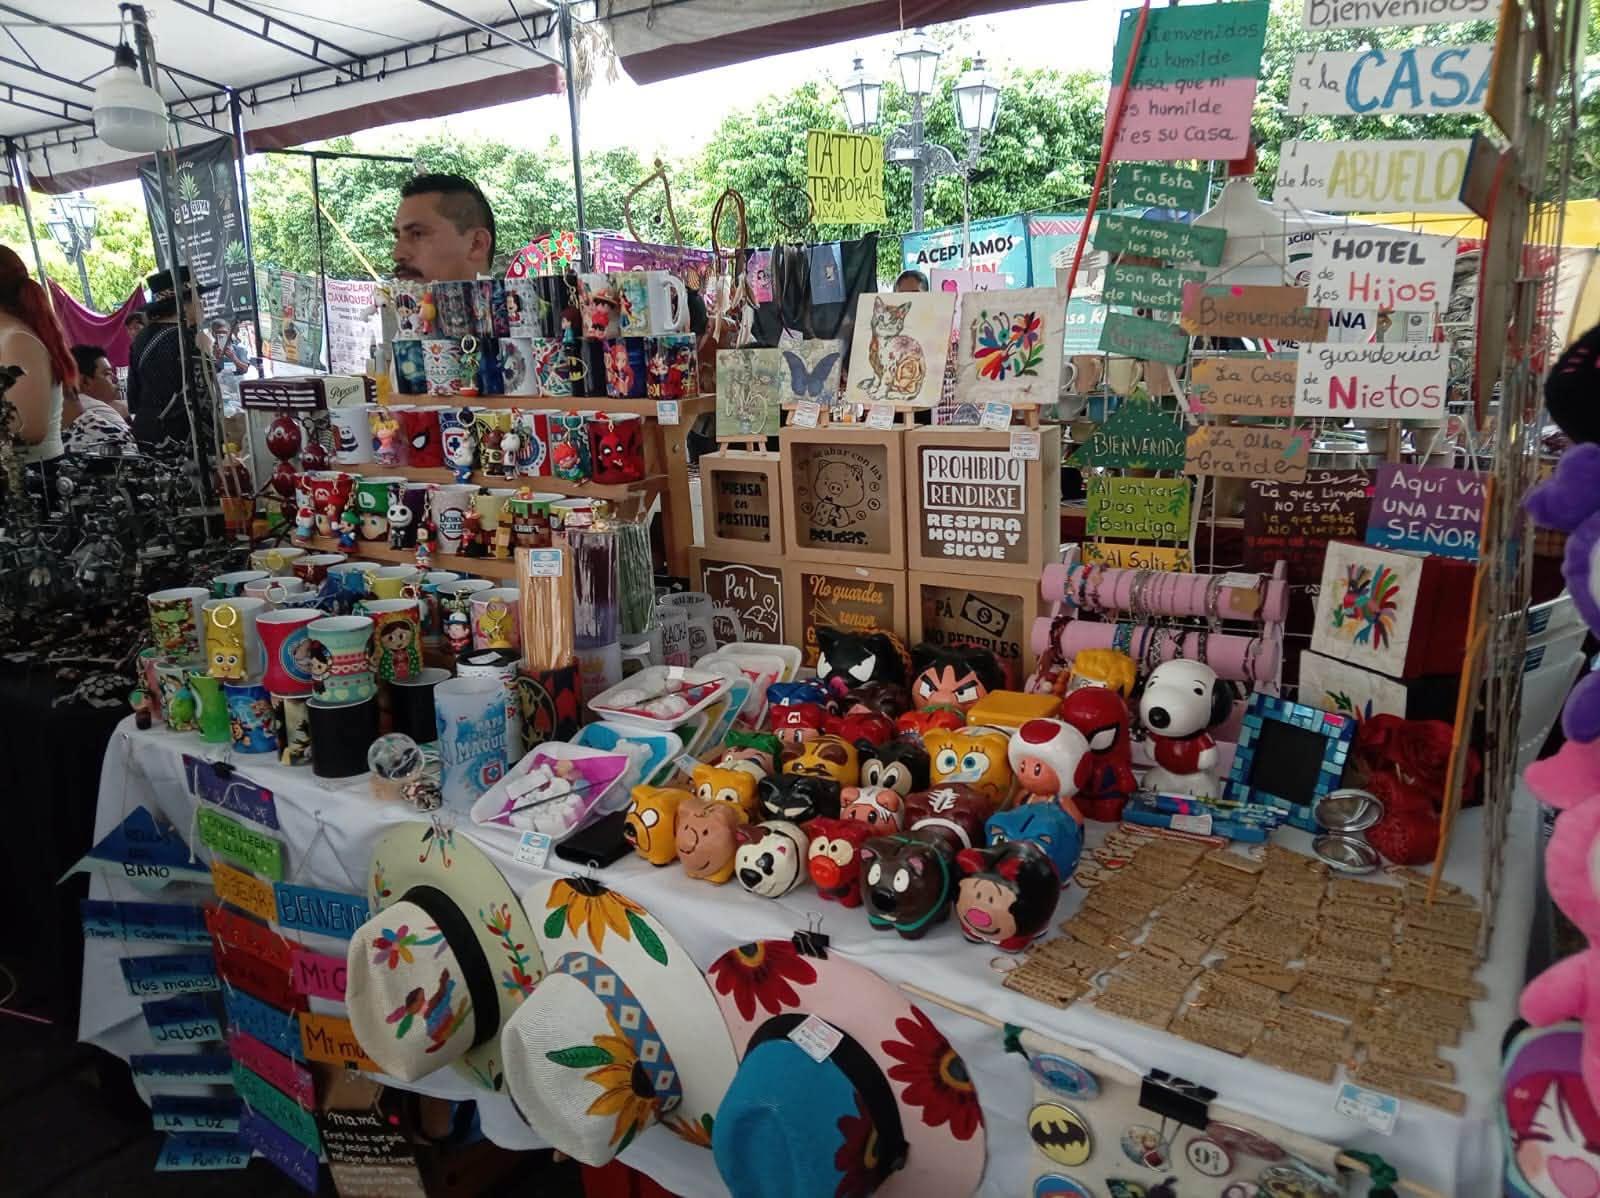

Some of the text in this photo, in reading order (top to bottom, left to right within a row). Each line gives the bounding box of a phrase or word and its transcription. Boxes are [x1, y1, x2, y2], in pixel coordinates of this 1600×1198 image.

[1163, 48, 1233, 68] humilde
[1131, 79, 1169, 92] asa,
[1175, 78, 1204, 95] que
[1299, 76, 1312, 90] a
[1318, 62, 1341, 93] la
[1149, 98, 1222, 116] humilde
[1130, 130, 1152, 145] es
[1158, 128, 1178, 142] su
[809, 131, 873, 177] TATTO
[1133, 169, 1195, 190] En Esta
[1277, 170, 1296, 188] de
[1300, 164, 1325, 188] los
[1133, 187, 1178, 208] Casa
[916, 235, 1013, 264] ACEPTAMOS
[1127, 241, 1195, 260] los gatos
[1331, 238, 1426, 266] HOTEL
[1115, 270, 1145, 284] Son
[1318, 267, 1336, 281] de
[1105, 285, 1185, 306] de Nuestr
[1348, 271, 1438, 313] Hijos
[1216, 366, 1295, 384] La Casa
[1304, 372, 1320, 385] de
[1199, 390, 1218, 405] ES
[1328, 374, 1442, 411] Nietos
[928, 454, 1021, 481] PROHIBIDO
[1199, 450, 1291, 475] Grande
[1259, 486, 1281, 499] La
[1290, 488, 1315, 502] que
[1390, 470, 1448, 499] Aquí
[930, 484, 1018, 509] RENDIRSE
[1100, 498, 1136, 515] Dios
[1274, 501, 1295, 513] NO
[1382, 497, 1428, 521] UNA
[718, 511, 770, 529] POSITIVO
[927, 513, 1022, 532] RESPIRA
[1100, 516, 1178, 538] Bendiga
[928, 528, 1020, 546] HONDO Y
[1387, 518, 1482, 550] SEÑOR
[943, 544, 1006, 559] SIGUE
[1106, 552, 1123, 568] Al
[810, 575, 832, 597] No
[279, 889, 371, 931] BIENVENID
